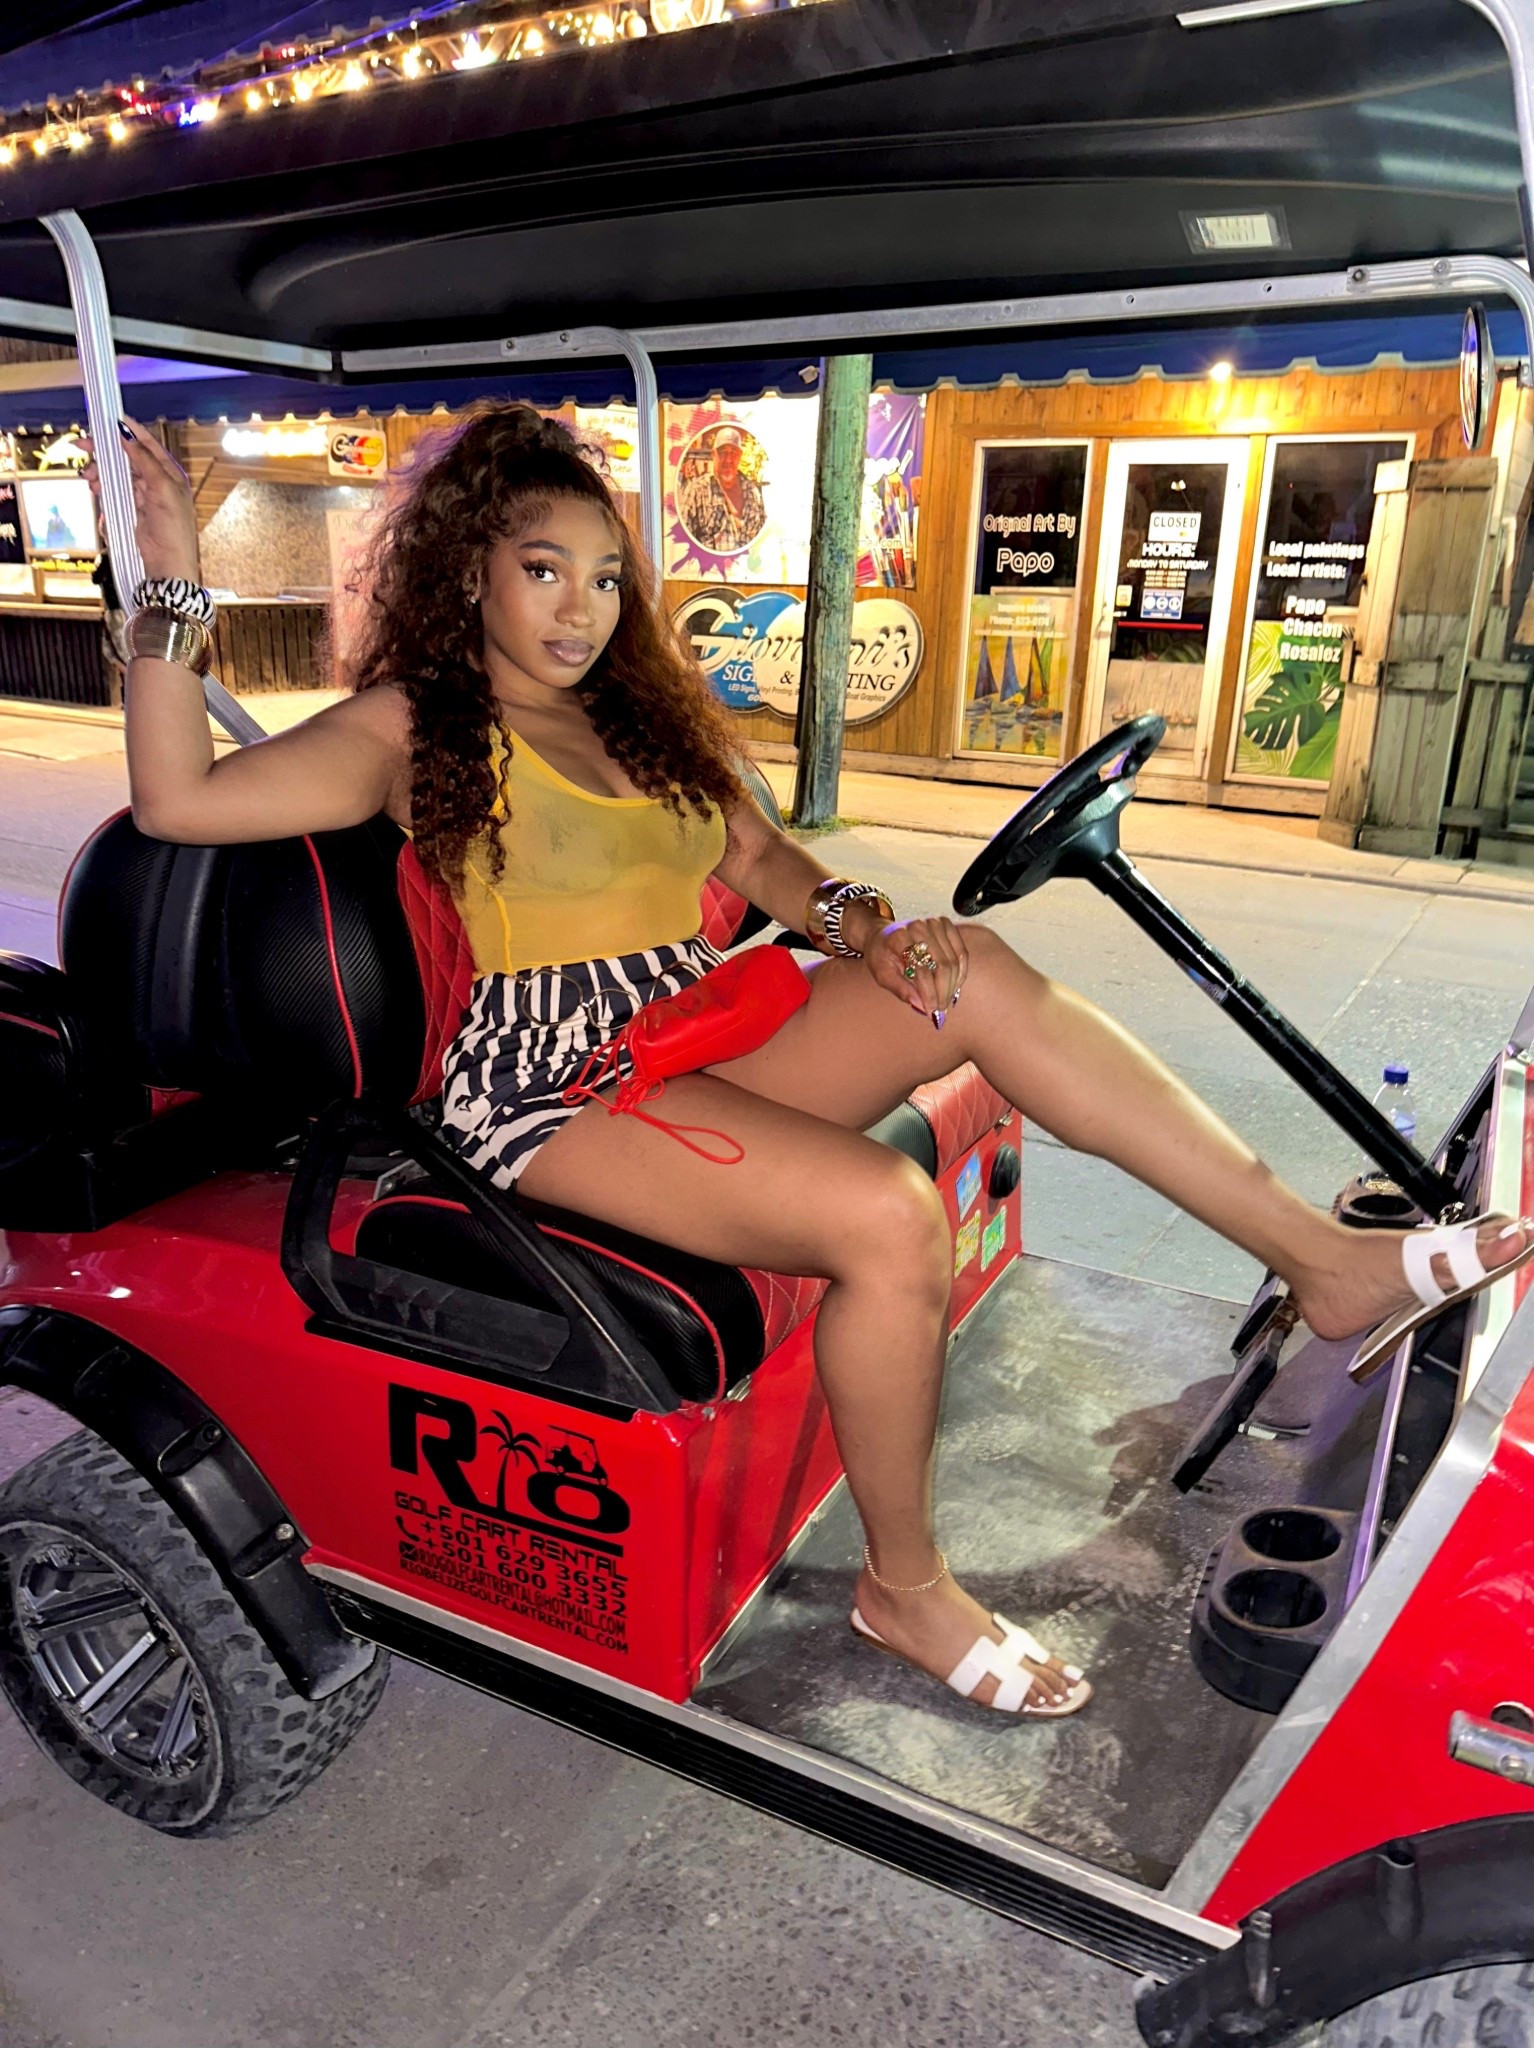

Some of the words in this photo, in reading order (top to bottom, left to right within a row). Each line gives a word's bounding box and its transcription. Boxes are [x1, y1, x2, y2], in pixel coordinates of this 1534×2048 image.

[983, 513, 1031, 538] Original
[1033, 513, 1055, 532] Art
[1057, 513, 1076, 539] By
[1153, 516, 1197, 528] CLOSED
[1142, 542, 1196, 558] HOURS:
[1269, 541, 1303, 557] Local
[1304, 542, 1365, 561] paintings
[996, 548, 1054, 577] Papo
[1159, 559, 1168, 569] TO
[1169, 560, 1209, 571] SATURDAY
[1266, 561, 1301, 577] Local
[1285, 595, 1326, 616] Papo
[1283, 618, 1343, 638] Chacon
[780, 671, 794, 684] &
[388, 1382, 630, 1533] RIO
[394, 1490, 453, 1522] GOLF
[460, 1512, 520, 1545] CART
[529, 1534, 628, 1582] RENTAL
[420, 1520, 485, 1552] +501
[496, 1543, 545, 1572] 629
[555, 1563, 626, 1599] 3655
[424, 1538, 486, 1569] +501
[498, 1562, 547, 1590] 600
[557, 1581, 627, 1618] 3332
[401, 1560, 628, 1655] RIOBELIZEGOLFCARTRENTAL.COM
